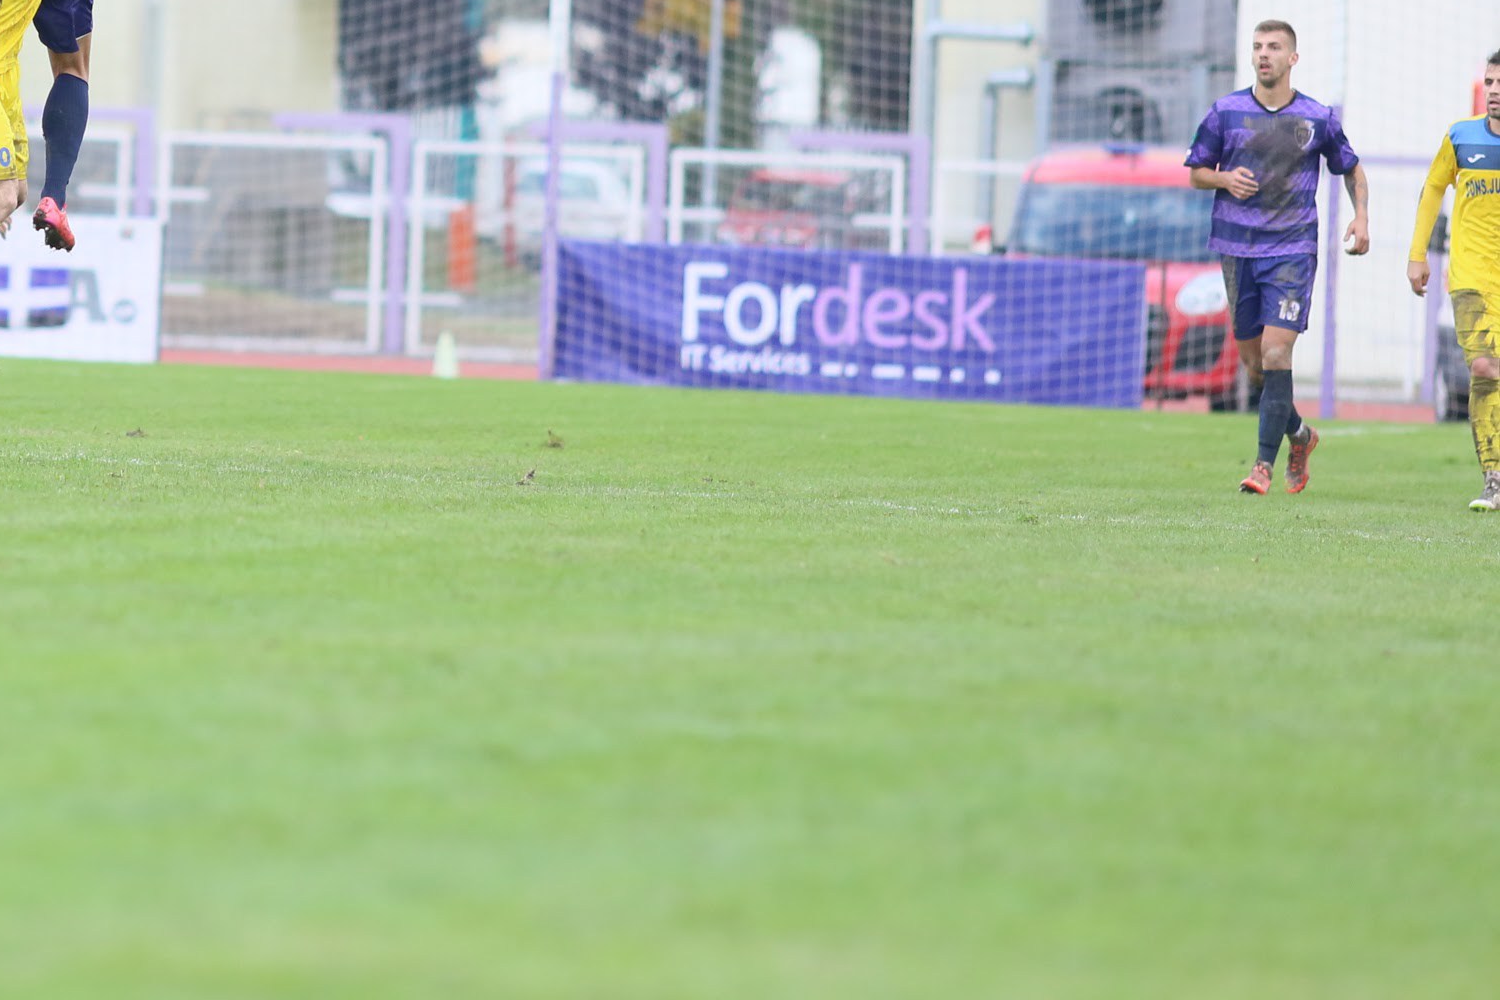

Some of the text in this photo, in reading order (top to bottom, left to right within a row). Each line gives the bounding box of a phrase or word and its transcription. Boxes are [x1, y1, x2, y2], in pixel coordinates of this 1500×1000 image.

[680, 261, 997, 353] Fordesk
[680, 344, 707, 370] IT
[709, 344, 811, 376] Services
